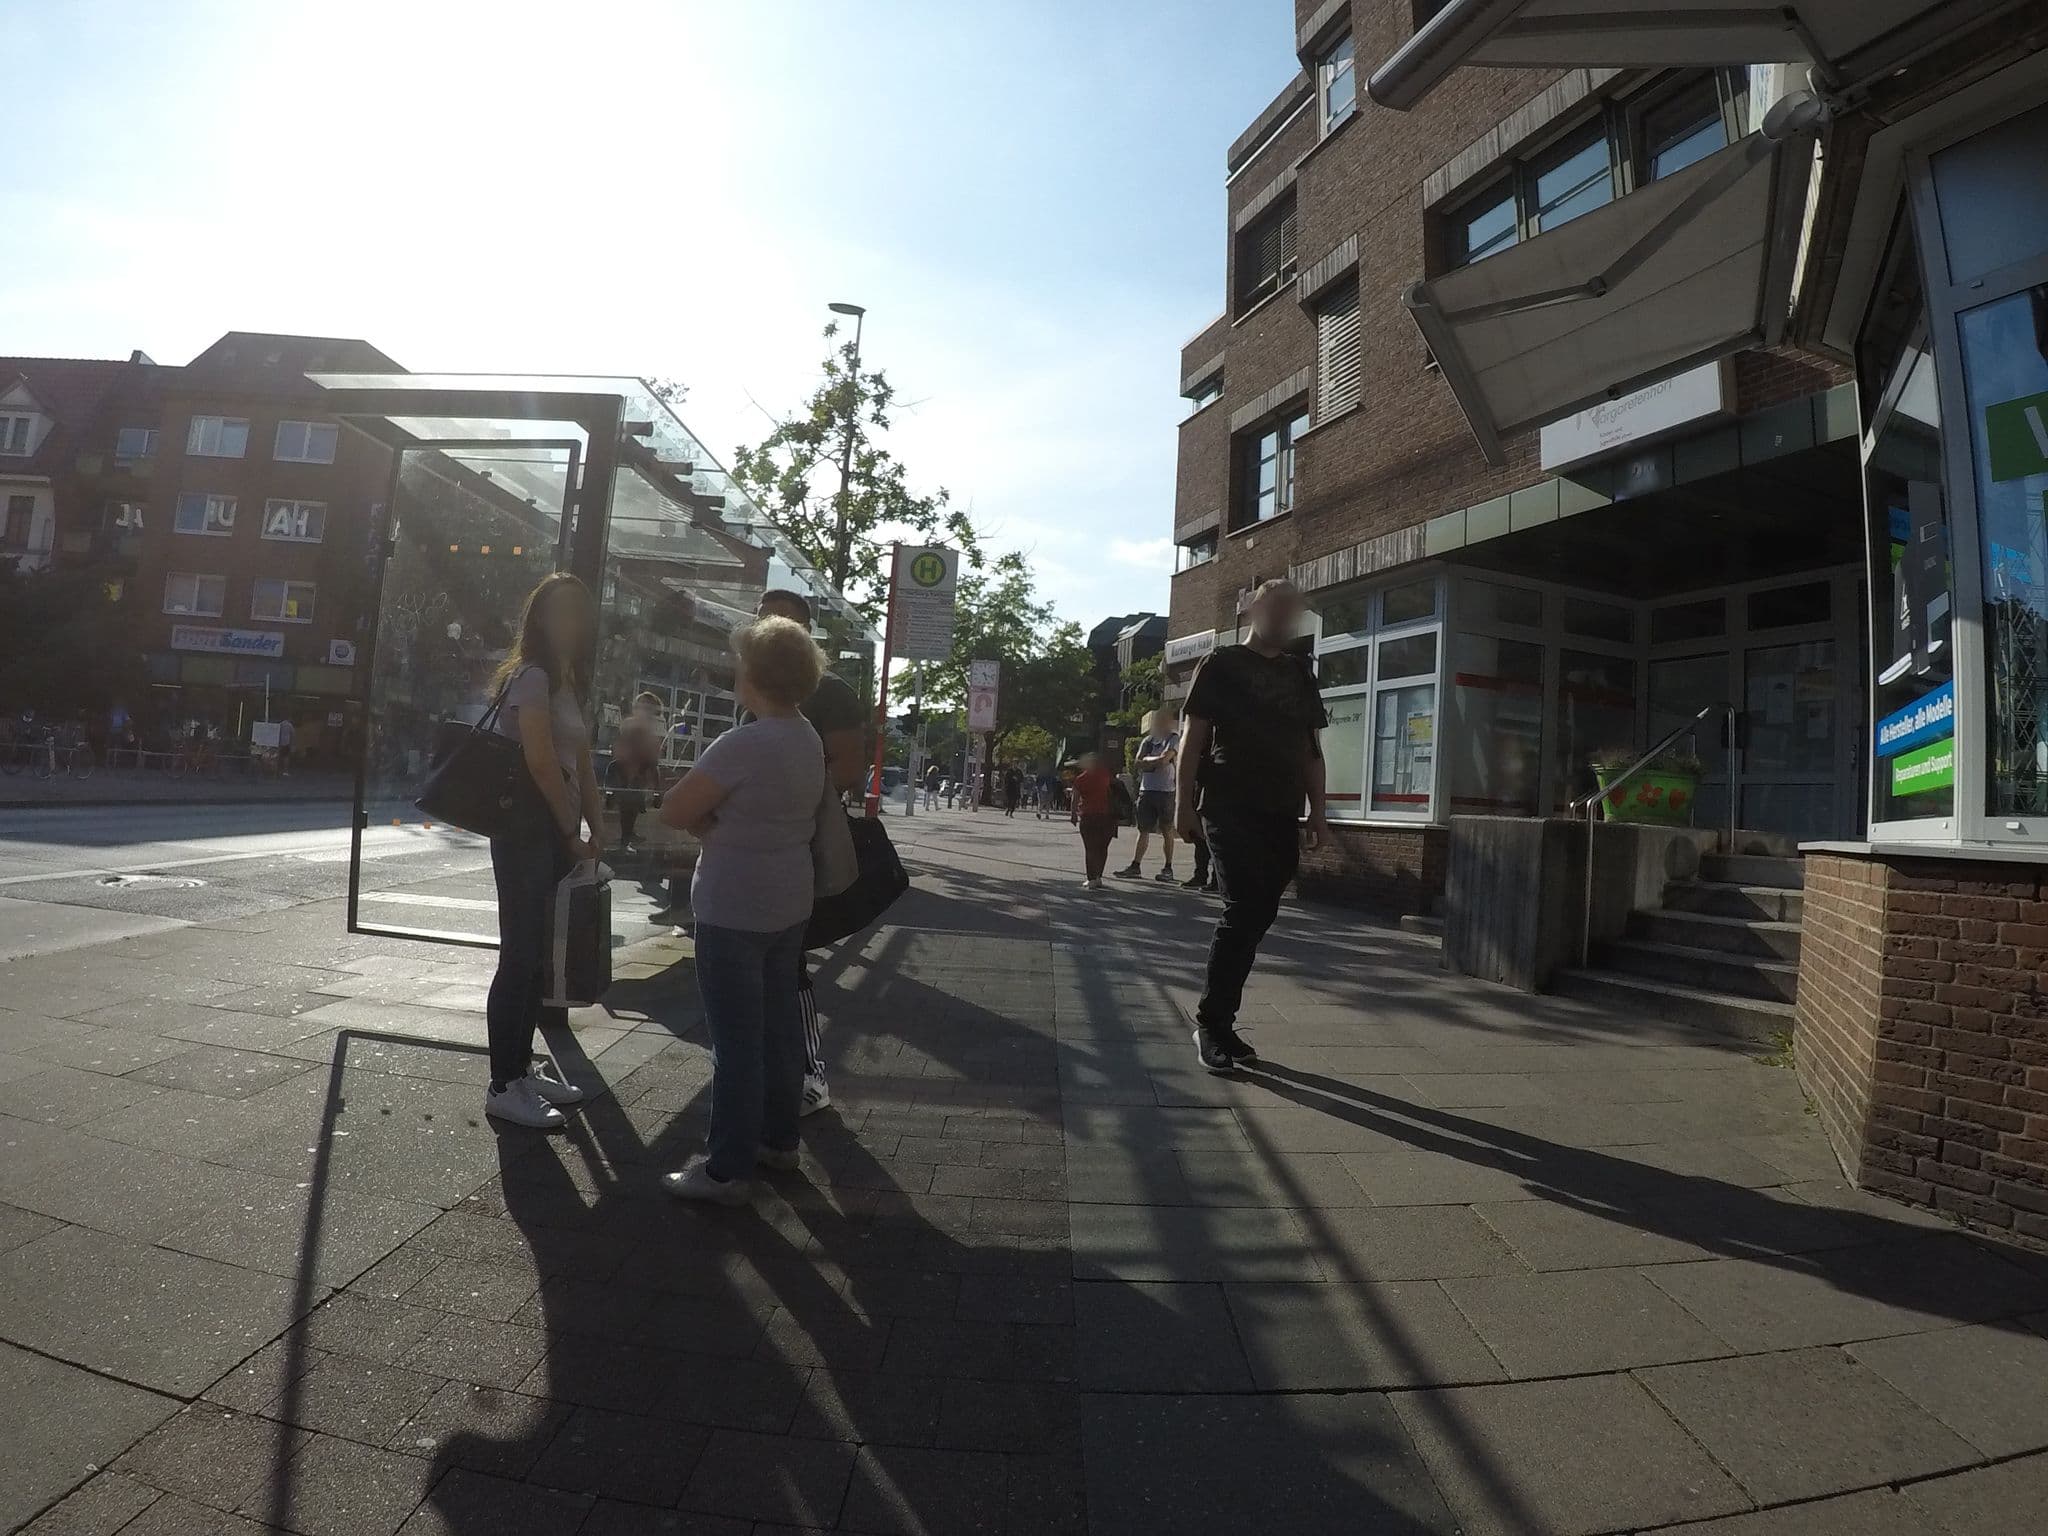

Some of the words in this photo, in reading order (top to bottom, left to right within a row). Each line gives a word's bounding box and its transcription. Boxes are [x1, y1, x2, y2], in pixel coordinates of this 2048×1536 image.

[920, 560, 937, 580] H
[1915, 707, 1926, 731] alle
[1926, 694, 1953, 726] Modelle
[1931, 751, 1953, 775] Support
